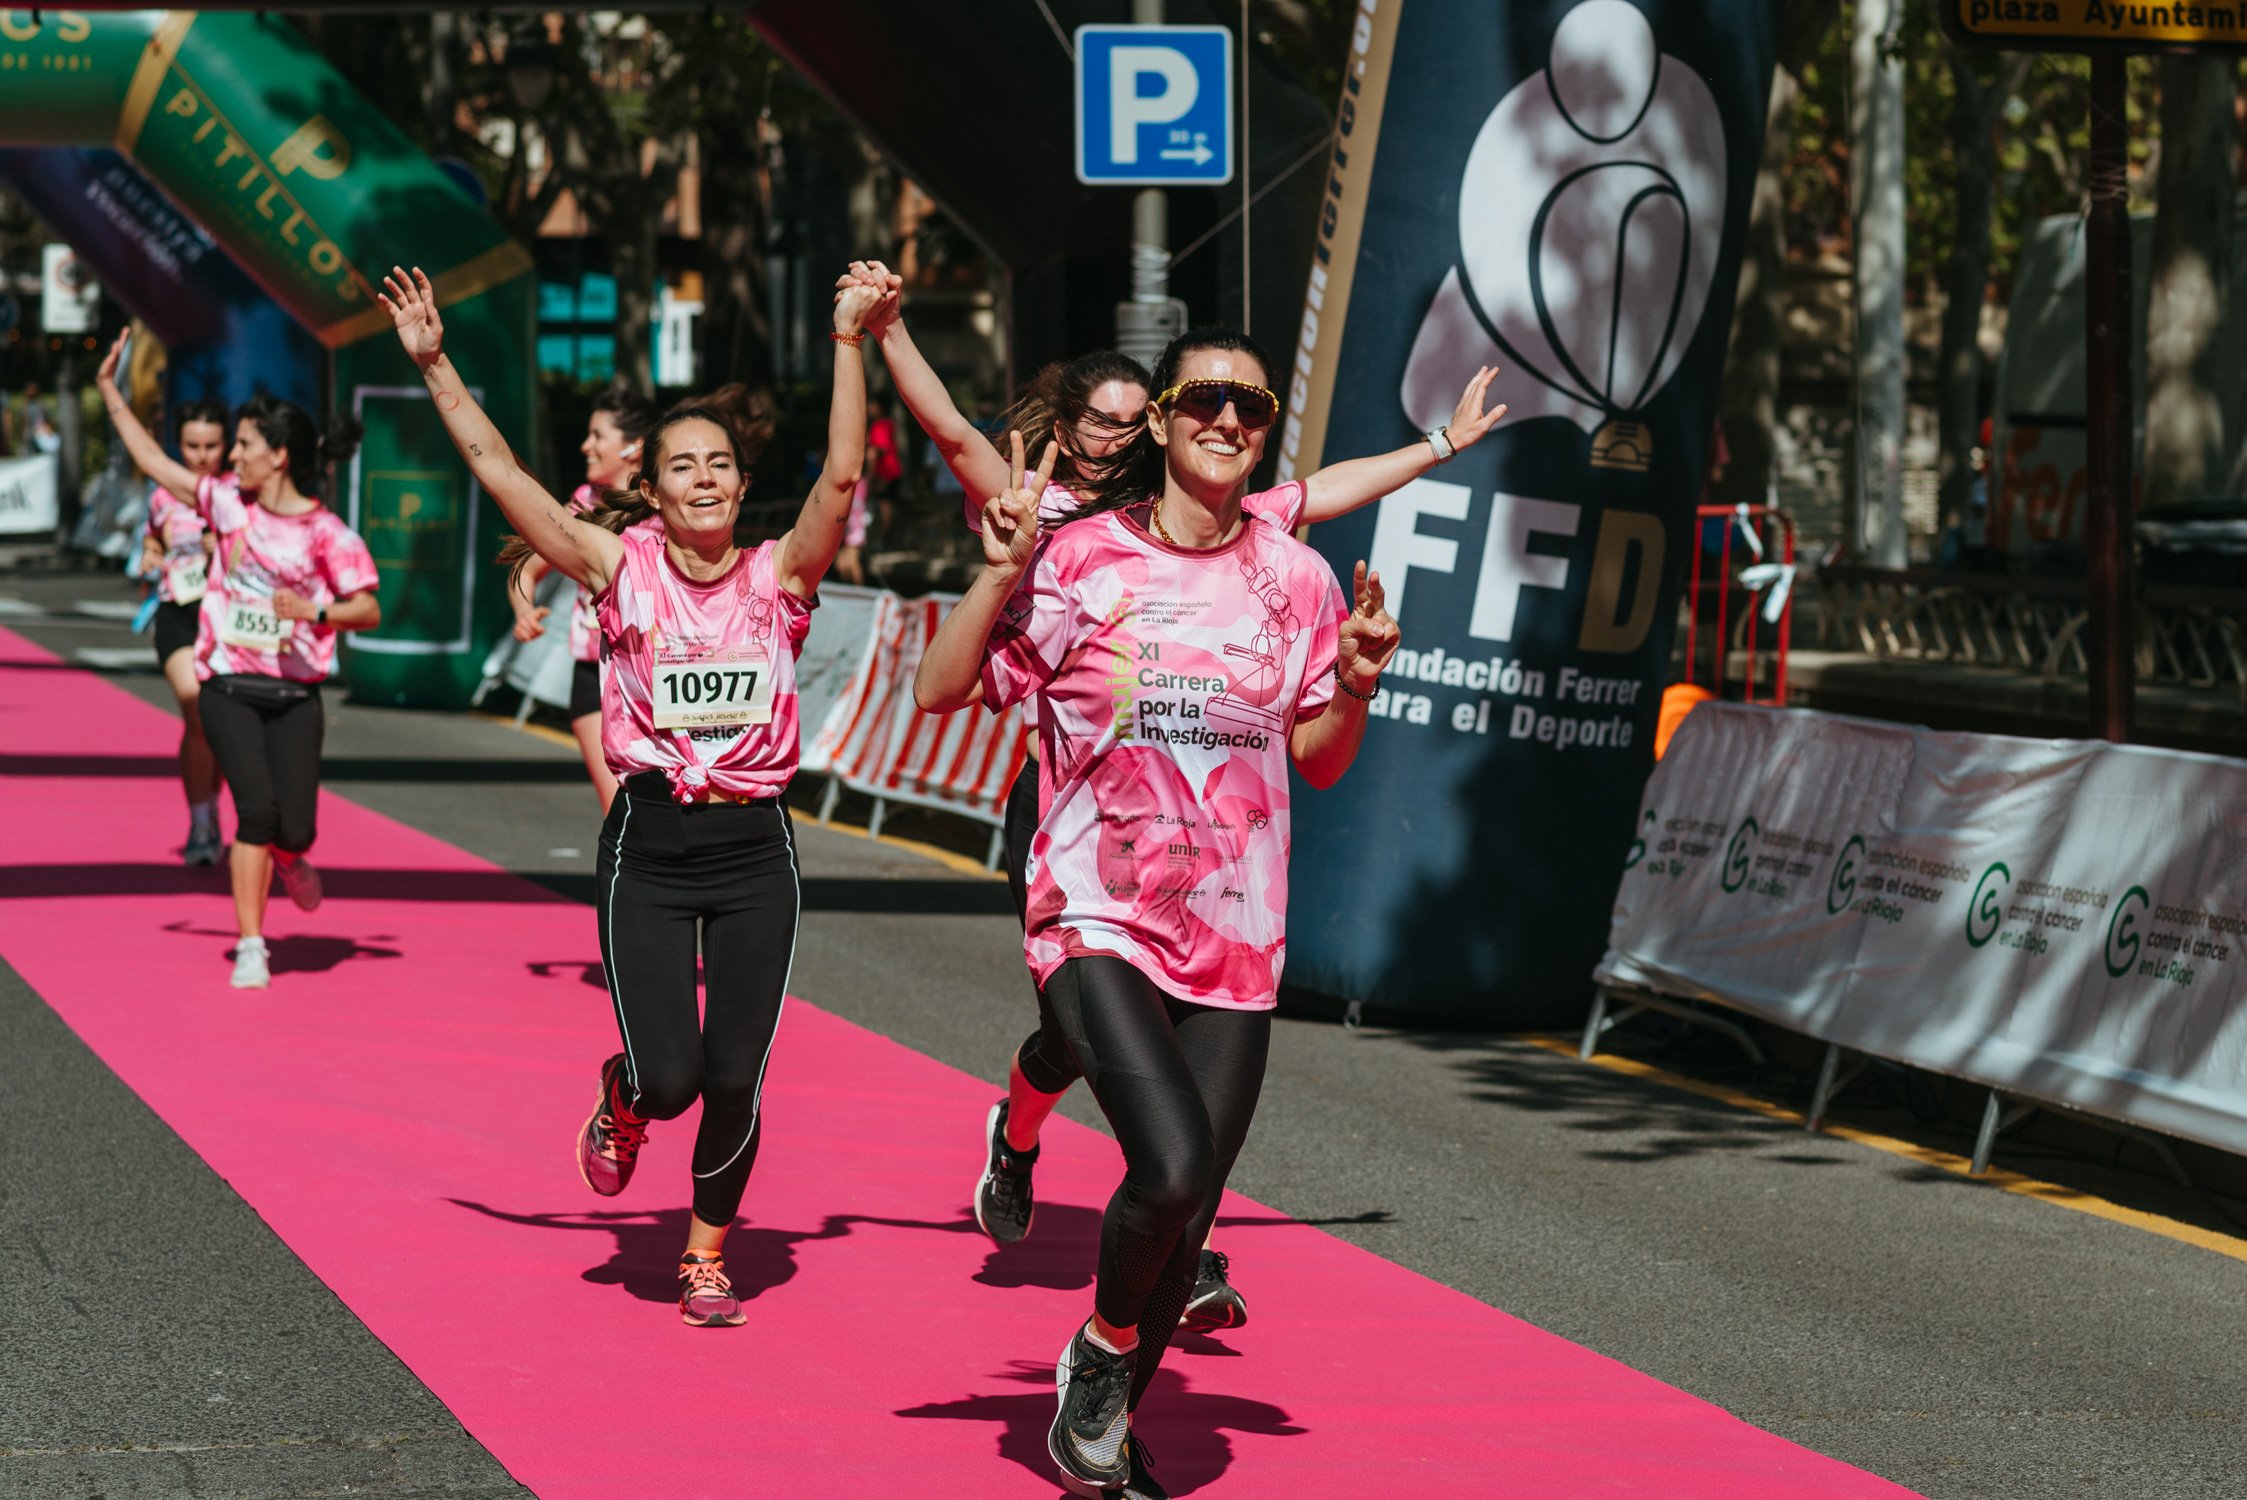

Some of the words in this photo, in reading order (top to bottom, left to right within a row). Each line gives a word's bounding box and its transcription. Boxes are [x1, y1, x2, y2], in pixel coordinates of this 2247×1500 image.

[1971, 0, 2059, 26] plaza
[1111, 47, 1199, 164] P
[1367, 478, 1665, 653] FFD
[1142, 600, 1178, 608] asociación
[1179, 600, 1212, 608] española
[1173, 608, 1197, 616] cáncer
[1162, 617, 1179, 625] Rioja
[1138, 642, 1159, 661] XI
[662, 671, 758, 704] 10977
[1105, 640, 1140, 740] mujer
[1138, 668, 1225, 693] Carrera
[1556, 667, 1641, 706] Ferrer
[1139, 699, 1176, 719] por
[1180, 698, 1199, 719] la
[1368, 688, 1432, 726] ara
[1451, 700, 1491, 735] el
[1509, 704, 1634, 751] Deporte
[2154, 958, 2168, 979] La
[2168, 960, 2194, 988] Rioja
